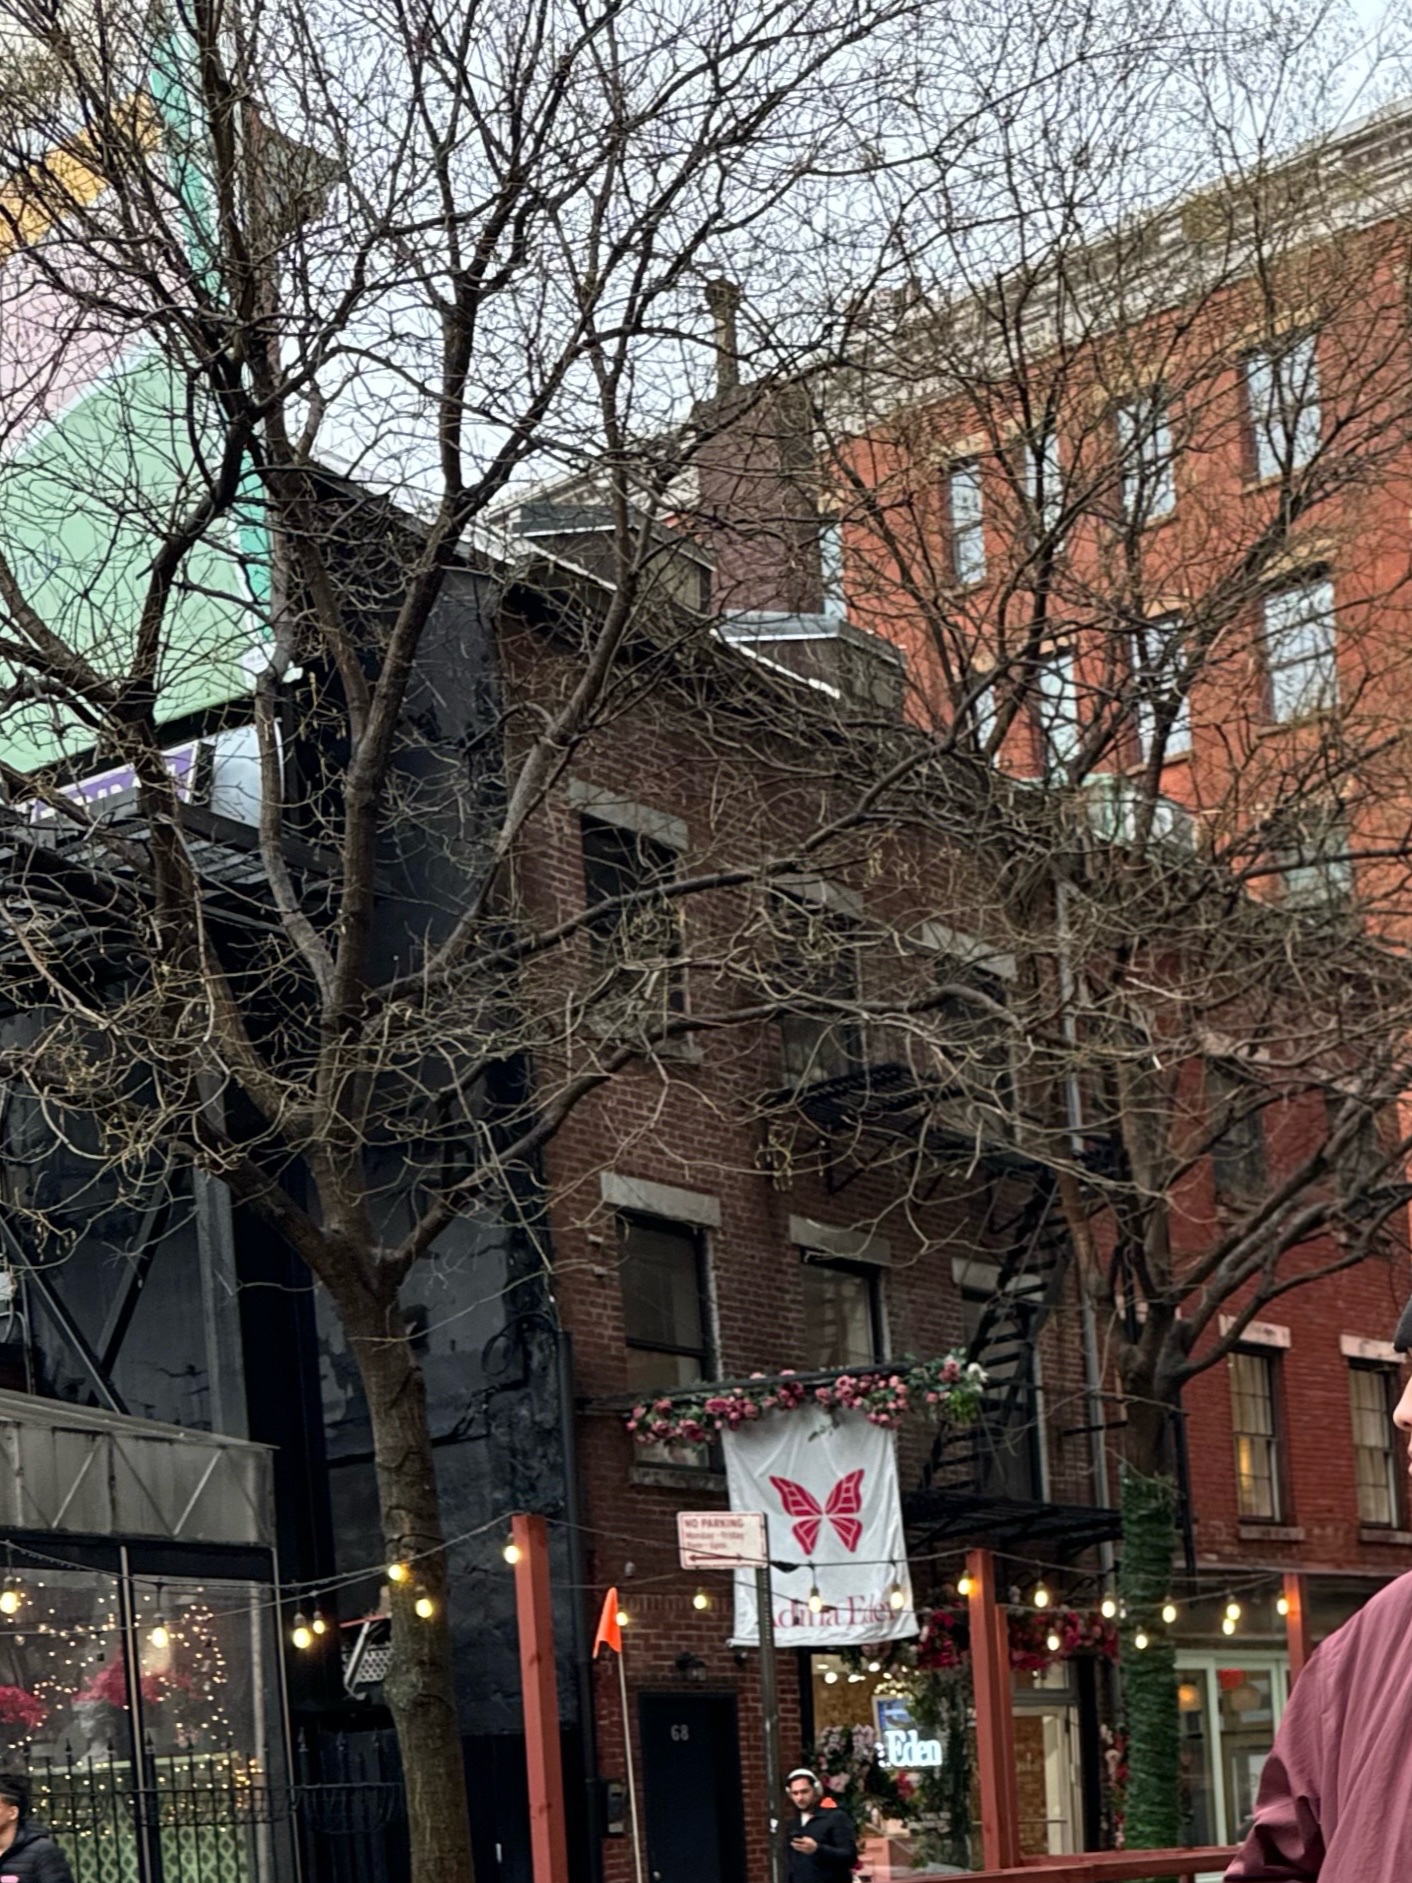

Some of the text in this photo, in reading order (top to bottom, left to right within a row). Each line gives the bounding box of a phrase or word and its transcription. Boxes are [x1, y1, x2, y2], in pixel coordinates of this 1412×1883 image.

[684, 1518, 744, 1528] NO PARKING
[670, 1725, 689, 1741] 68
[884, 1729, 943, 1767] Eden
